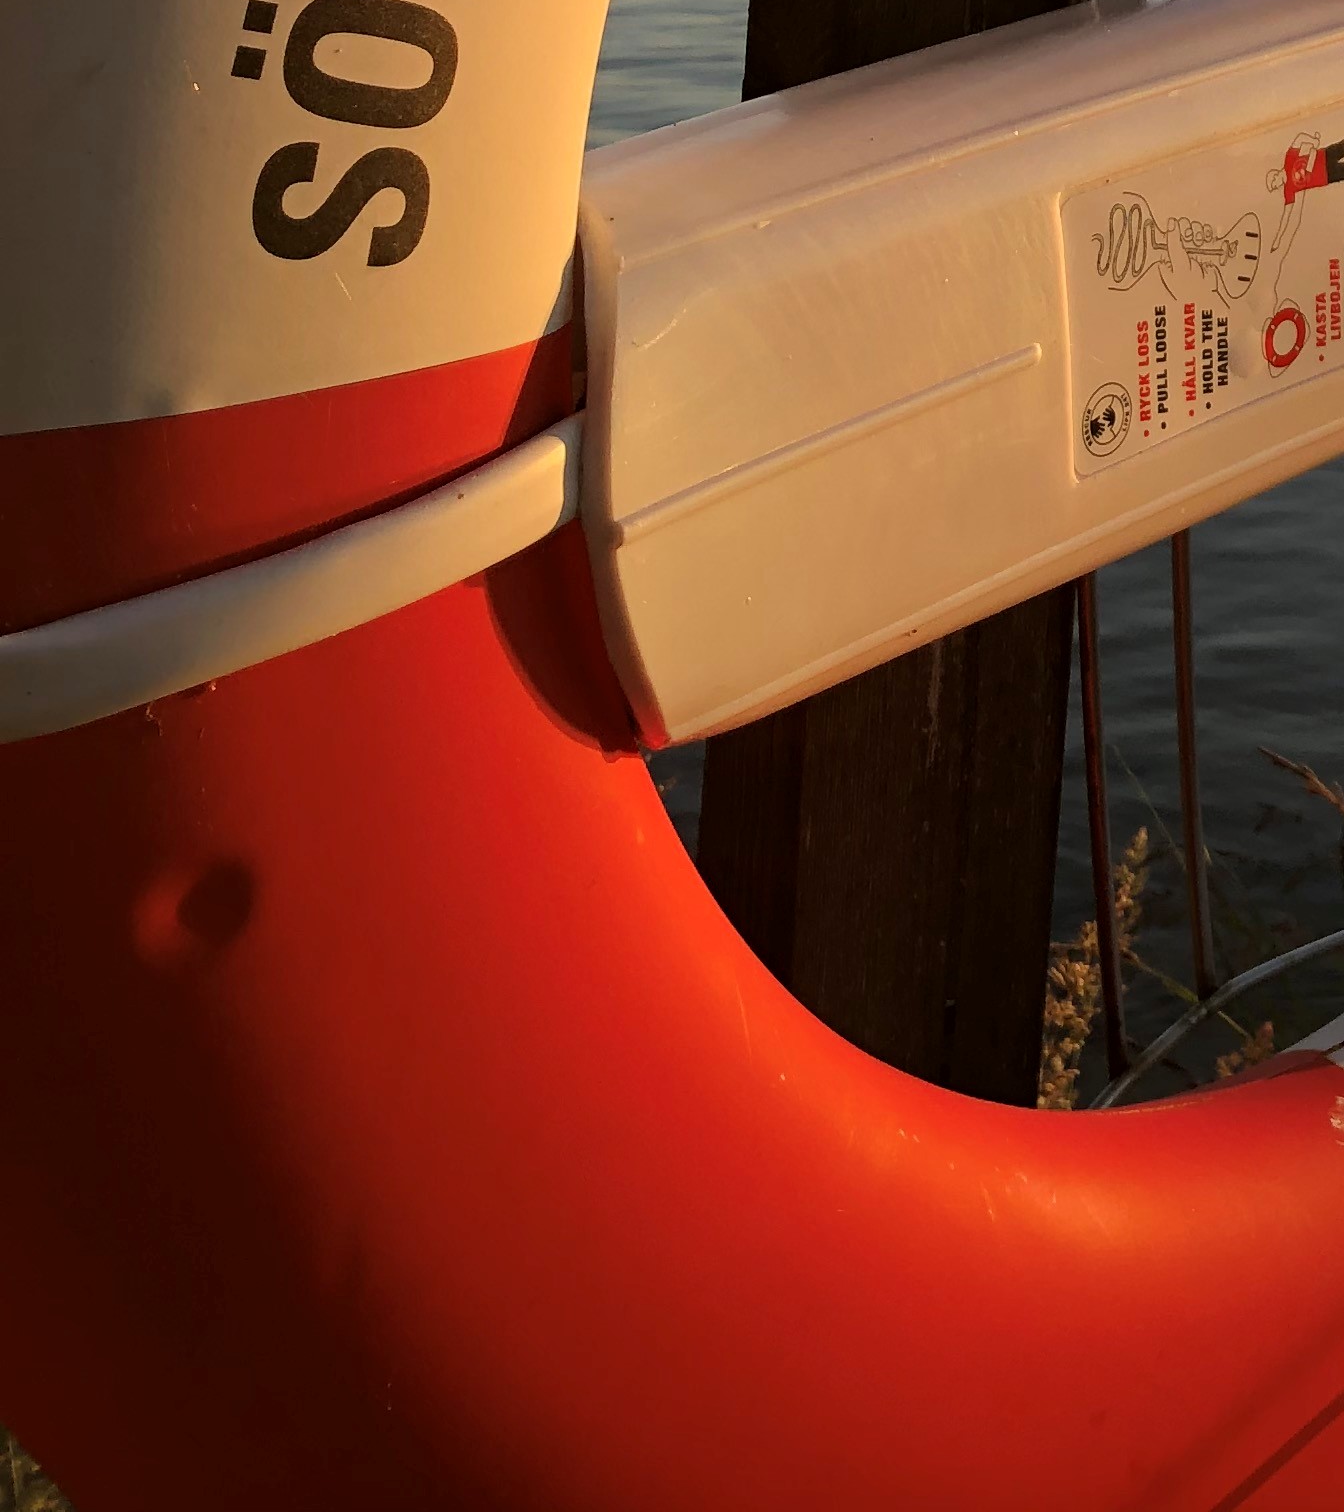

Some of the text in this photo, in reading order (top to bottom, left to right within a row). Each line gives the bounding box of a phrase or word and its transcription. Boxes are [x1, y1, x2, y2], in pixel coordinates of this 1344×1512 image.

[1315, 292, 1327, 347] KASTA
[1329, 257, 1341, 341] LIVBOJEN
[1136, 319, 1152, 422] RYCK LOSS
[1154, 305, 1169, 414] PULL LOOSE
[1182, 302, 1197, 402] HÅLL KVAR
[1201, 309, 1214, 394] HOLD THE
[1217, 316, 1229, 386] HANDLE
